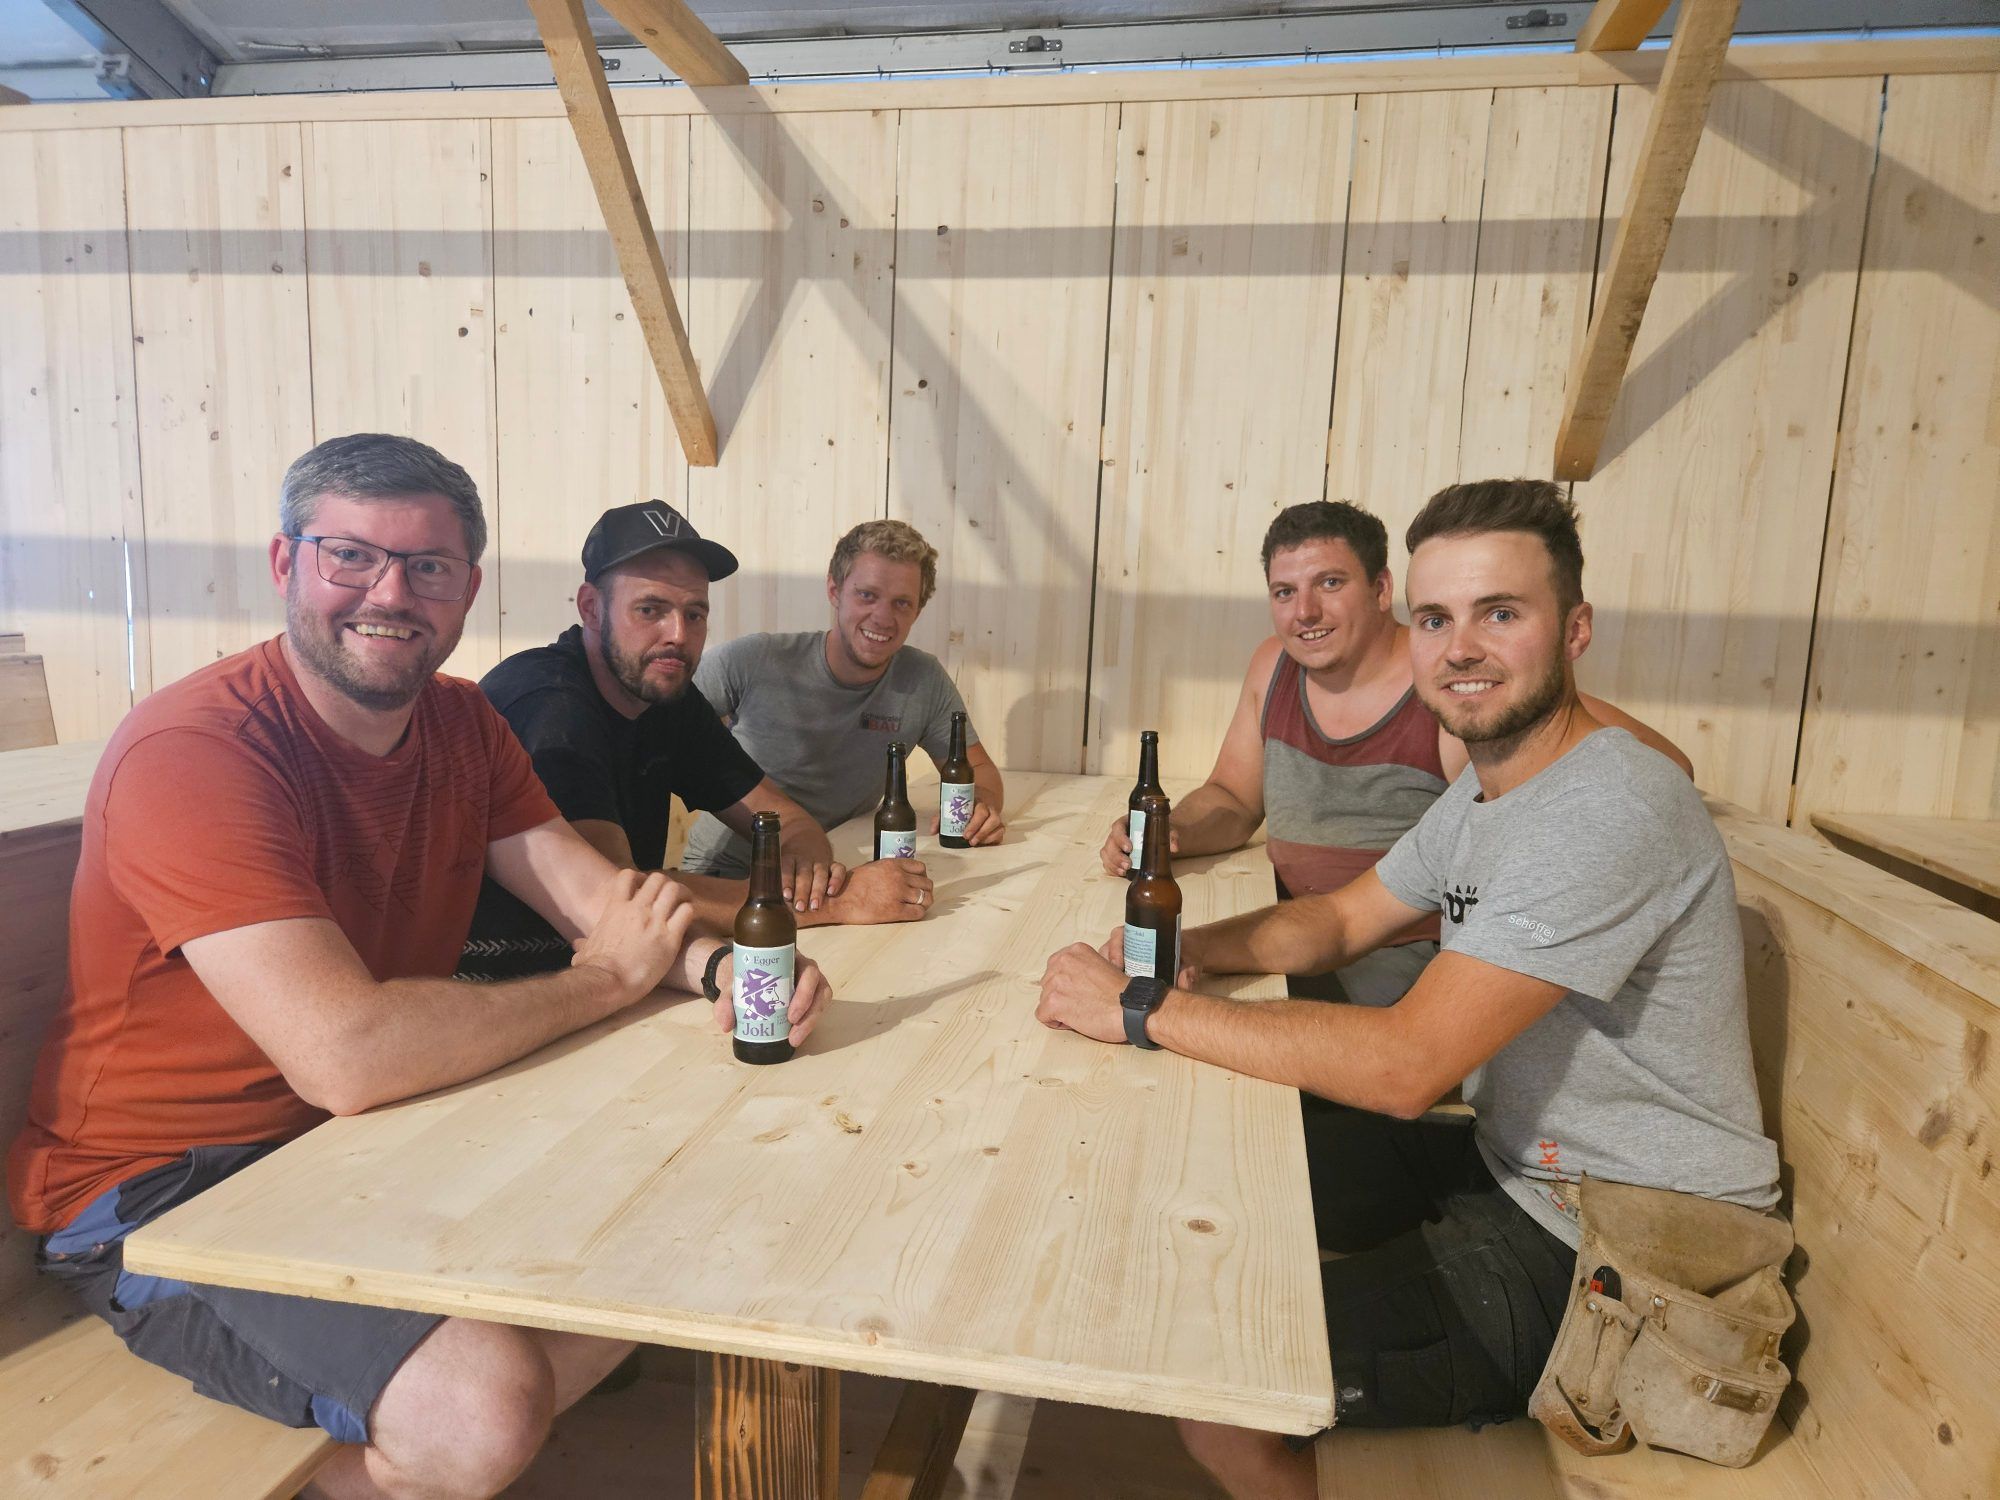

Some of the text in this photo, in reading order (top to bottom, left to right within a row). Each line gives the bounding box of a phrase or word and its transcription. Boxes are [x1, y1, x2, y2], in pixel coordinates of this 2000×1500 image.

[868, 720, 902, 733] BAU
[753, 955, 780, 966] Egger
[742, 1022, 775, 1037] Jokl
